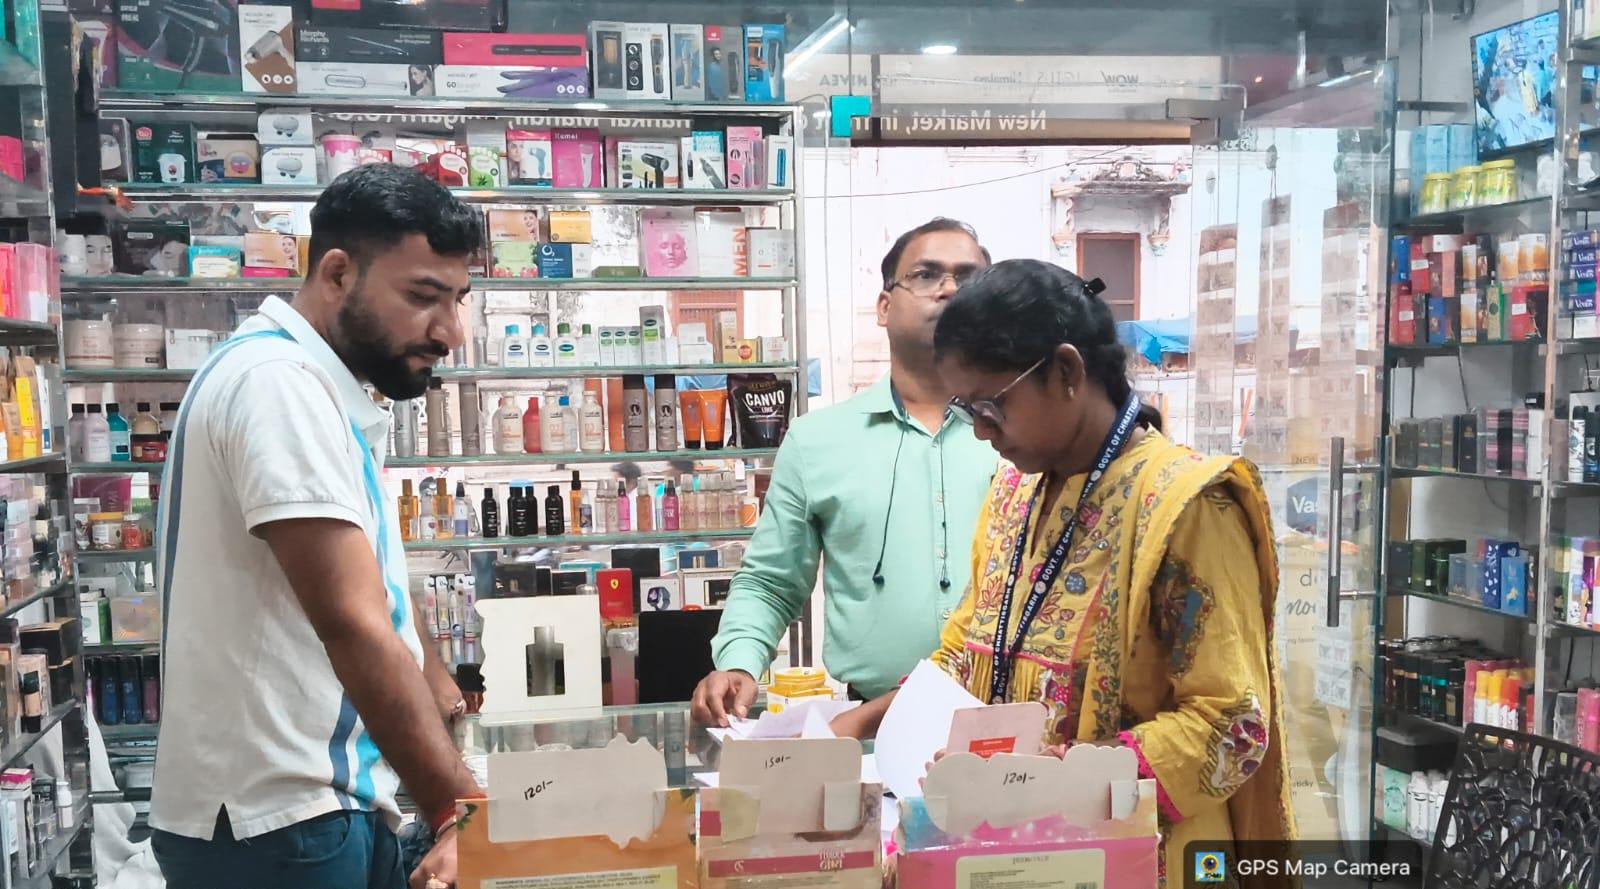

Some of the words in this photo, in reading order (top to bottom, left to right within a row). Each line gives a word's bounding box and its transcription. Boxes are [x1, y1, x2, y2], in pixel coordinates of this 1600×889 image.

[733, 227, 748, 276] MEN
[745, 390, 785, 407] CANVO
[1098, 443, 1117, 470] GOVT.
[1111, 434, 1122, 448] OF
[1041, 558, 1058, 582] GOVT.
[1054, 540, 1066, 556] OF
